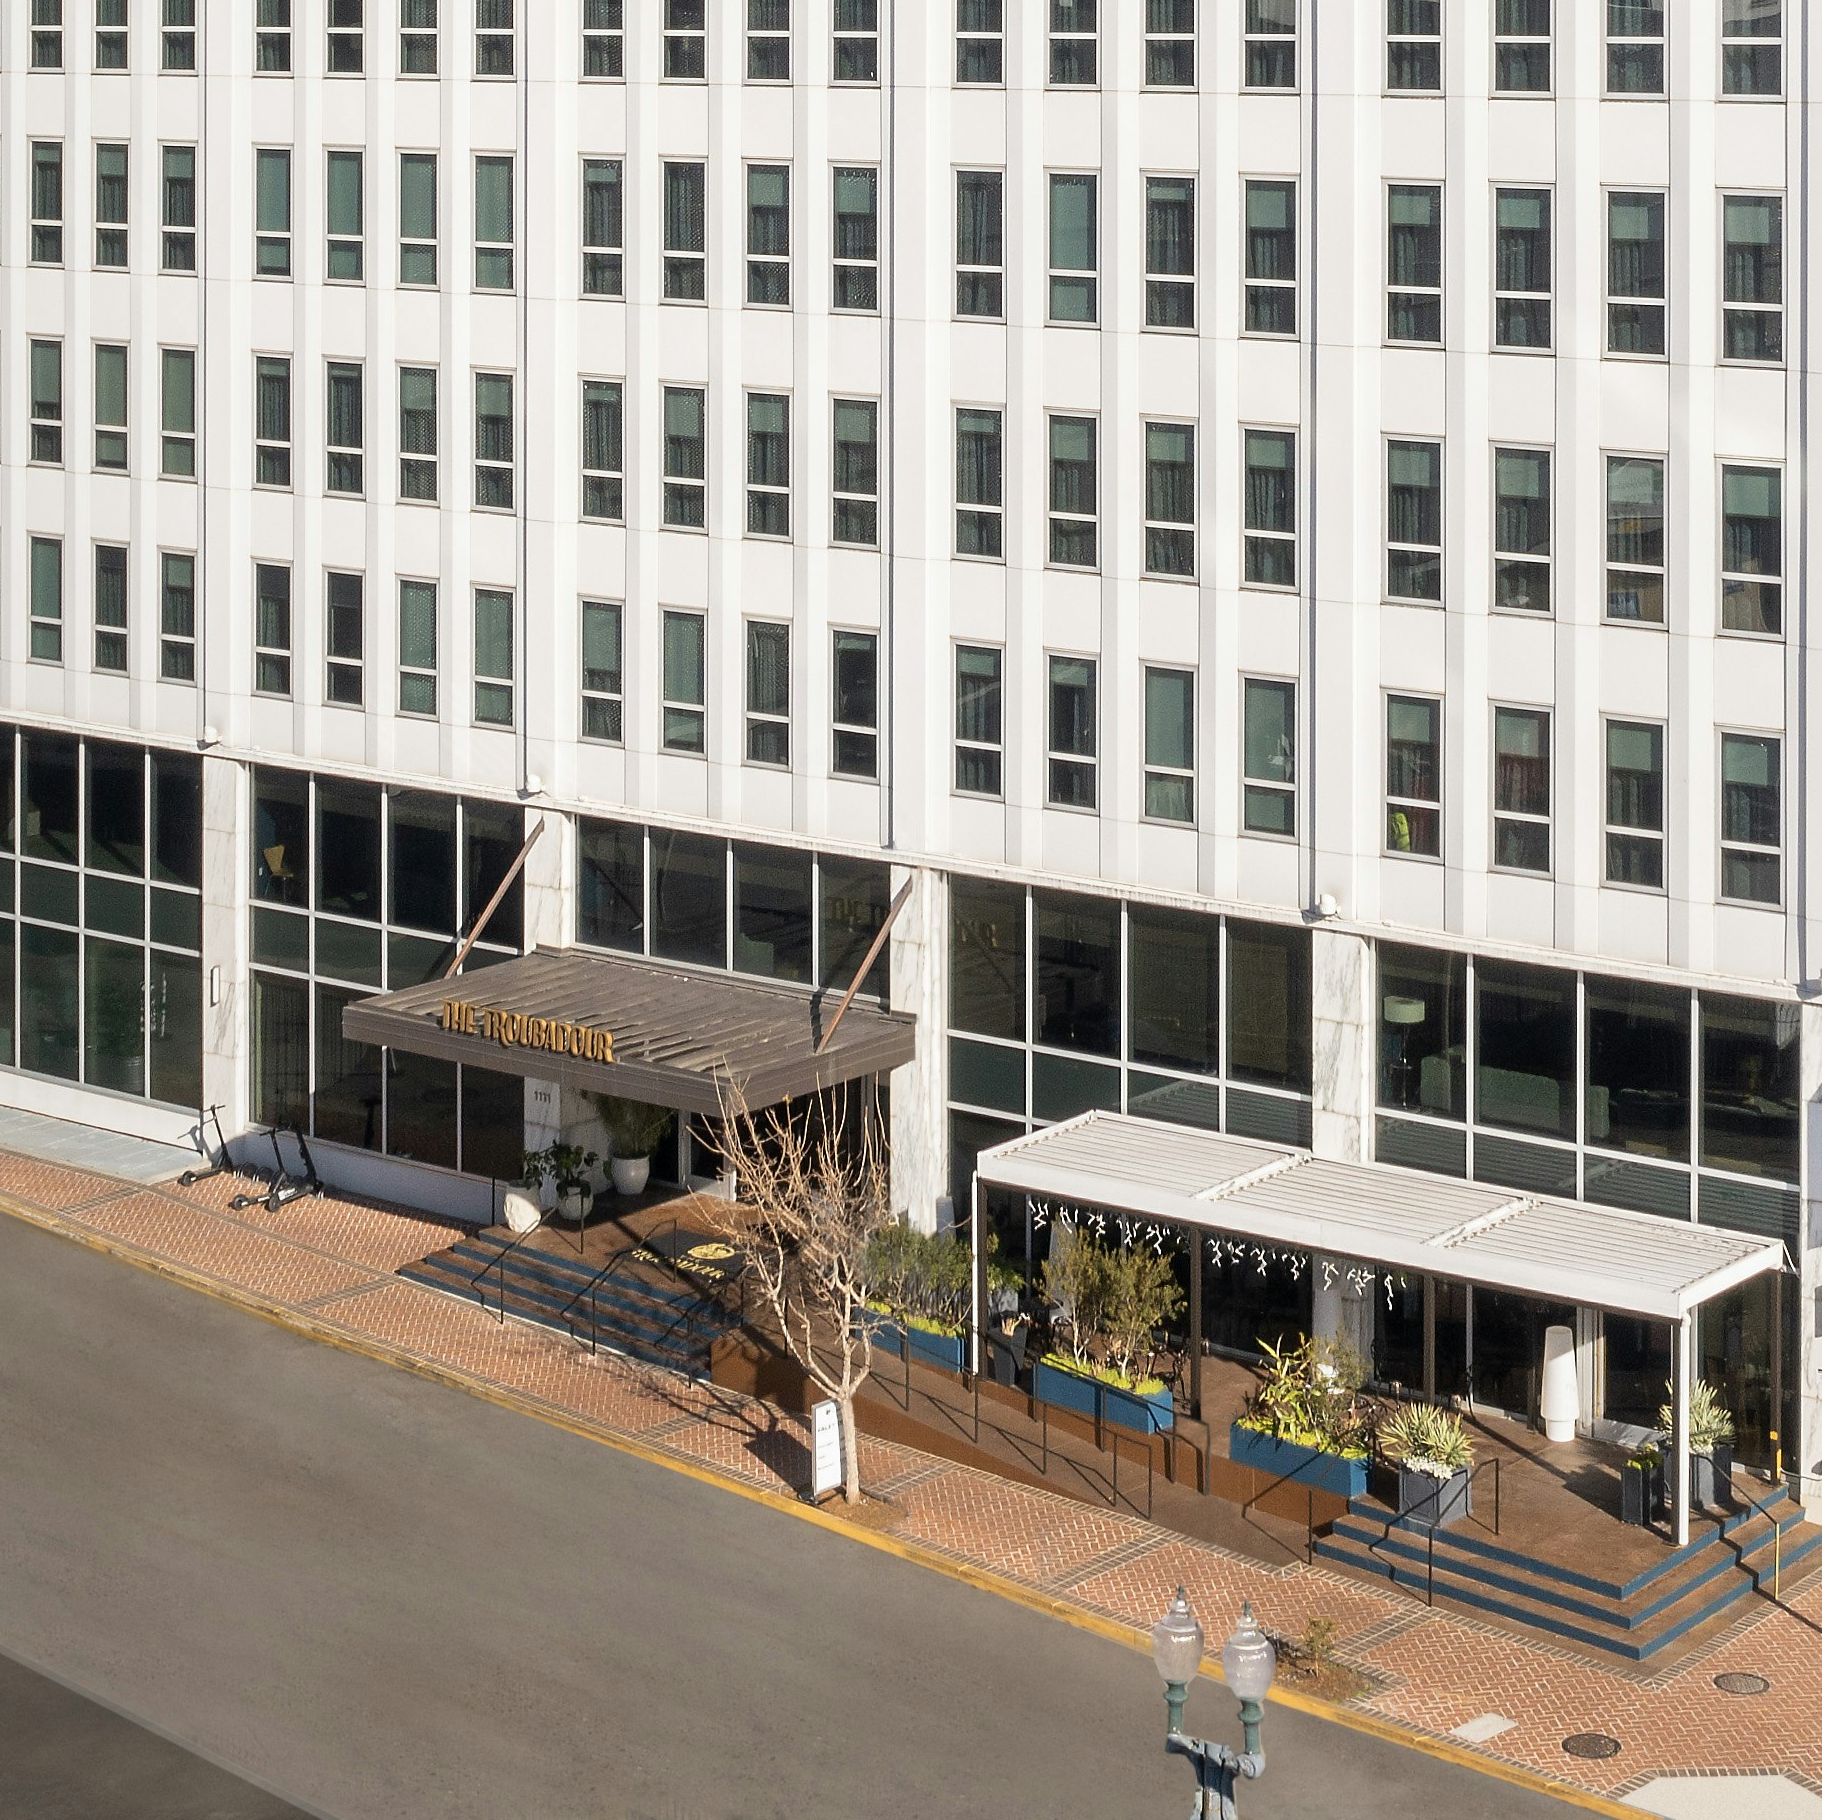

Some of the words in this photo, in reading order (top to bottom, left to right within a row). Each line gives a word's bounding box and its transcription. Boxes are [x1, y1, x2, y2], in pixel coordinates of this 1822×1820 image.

[441, 1000, 479, 1034] THE
[482, 1008, 616, 1064] TROUBADOUR
[534, 1091, 551, 1104] 1111
